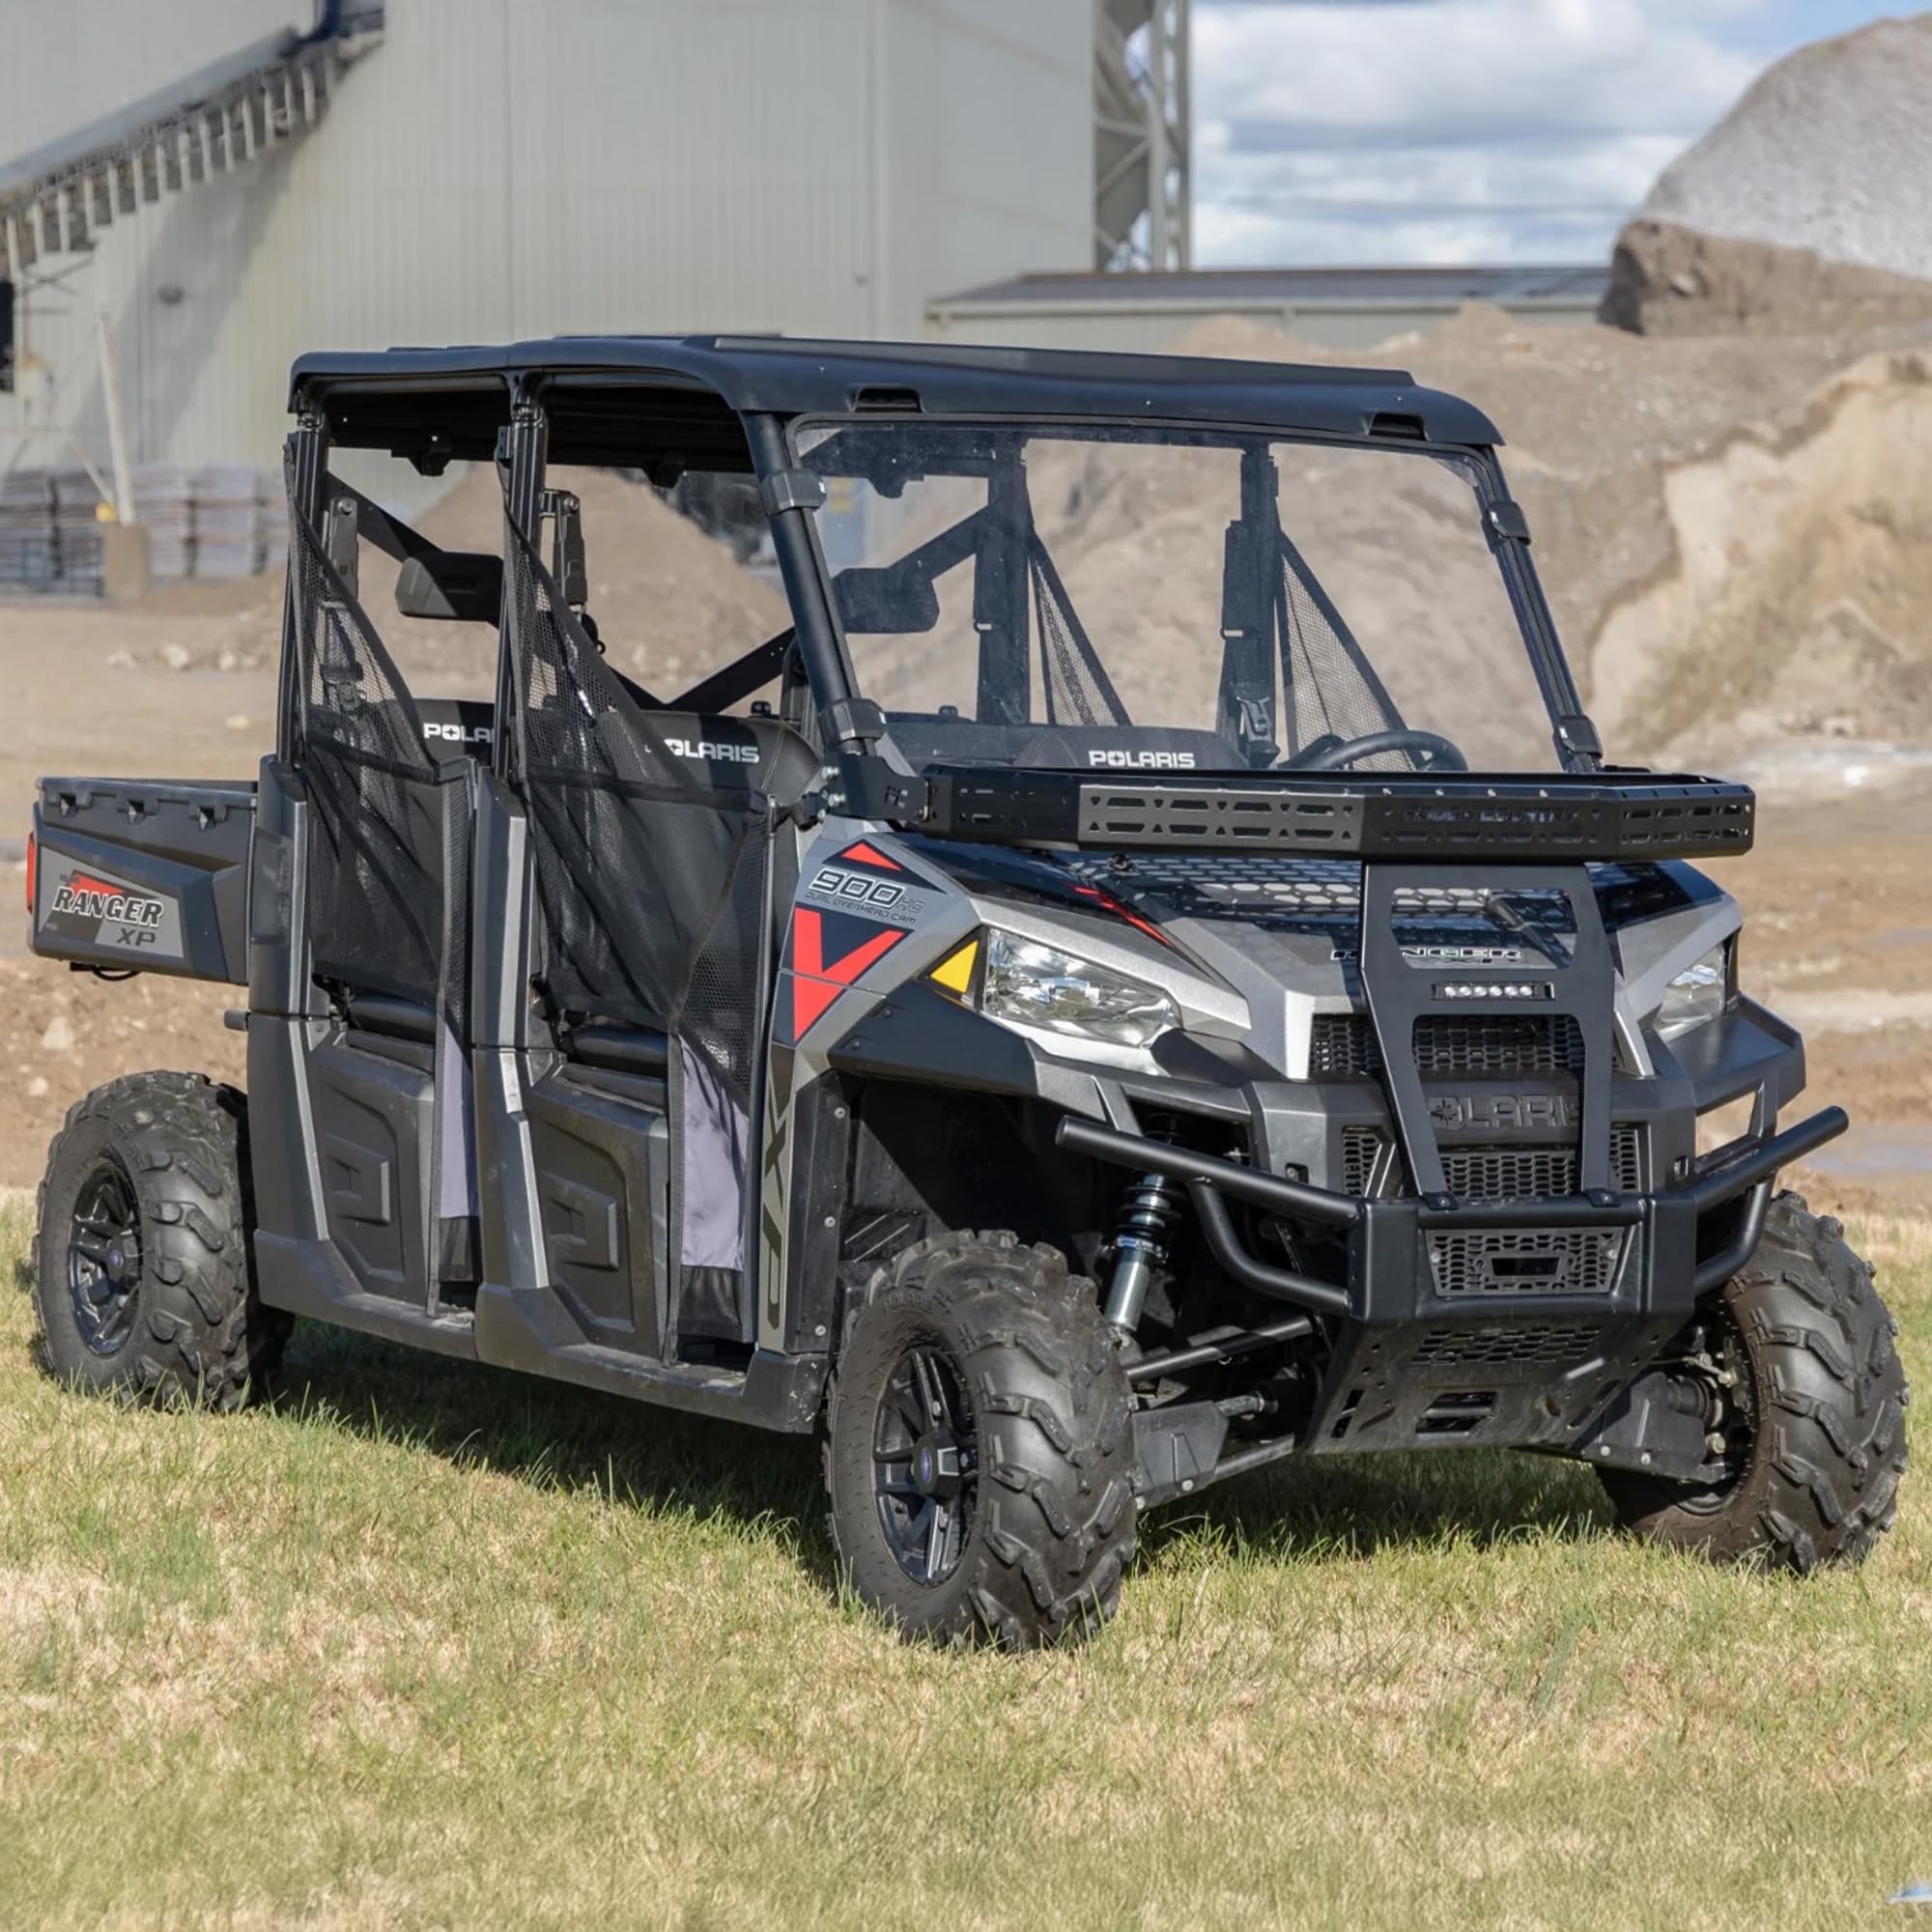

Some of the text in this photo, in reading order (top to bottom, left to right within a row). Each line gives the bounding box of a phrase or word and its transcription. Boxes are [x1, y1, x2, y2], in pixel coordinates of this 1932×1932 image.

[422, 723, 495, 744] POLA
[644, 738, 760, 764] OLARIS
[1088, 750, 1196, 769] POLARIS
[809, 867, 907, 908] 900
[52, 885, 163, 928] RANGER
[805, 891, 918, 925] DUAL OVERHEAD CAM
[116, 927, 156, 947] XP
[1330, 947, 1521, 961] RNGER
[1427, 1094, 1578, 1130] OLARI
